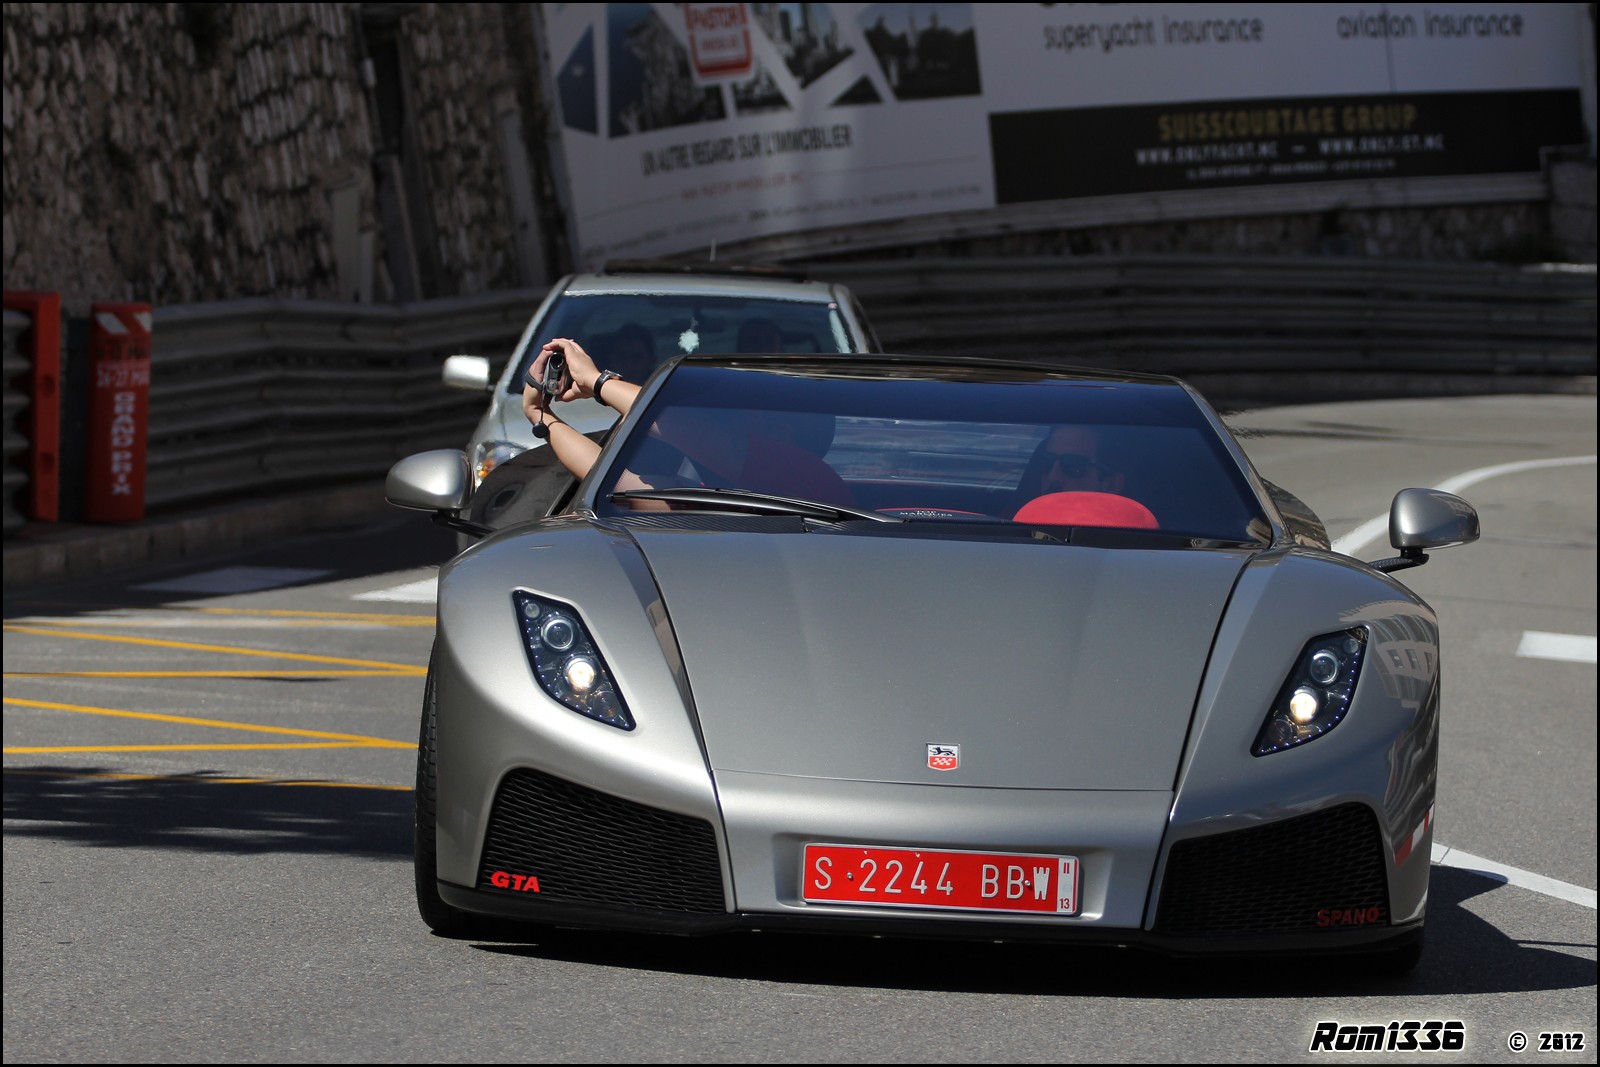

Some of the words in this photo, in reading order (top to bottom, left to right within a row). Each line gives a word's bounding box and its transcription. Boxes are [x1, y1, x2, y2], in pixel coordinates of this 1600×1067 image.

[1043, 16, 1154, 52] superyacht
[1164, 14, 1264, 43] insurance
[1337, 8, 1417, 39] aviation
[1424, 8, 1524, 37] insurance
[1158, 107, 1335, 142] SUISSCOURTAGE
[1342, 104, 1416, 132] GROUP
[491, 871, 540, 893] GTA
[814, 856, 833, 890] S
[858, 858, 954, 896] 2244
[1059, 898, 1070, 910] 13
[1316, 906, 1379, 927] SPANO
